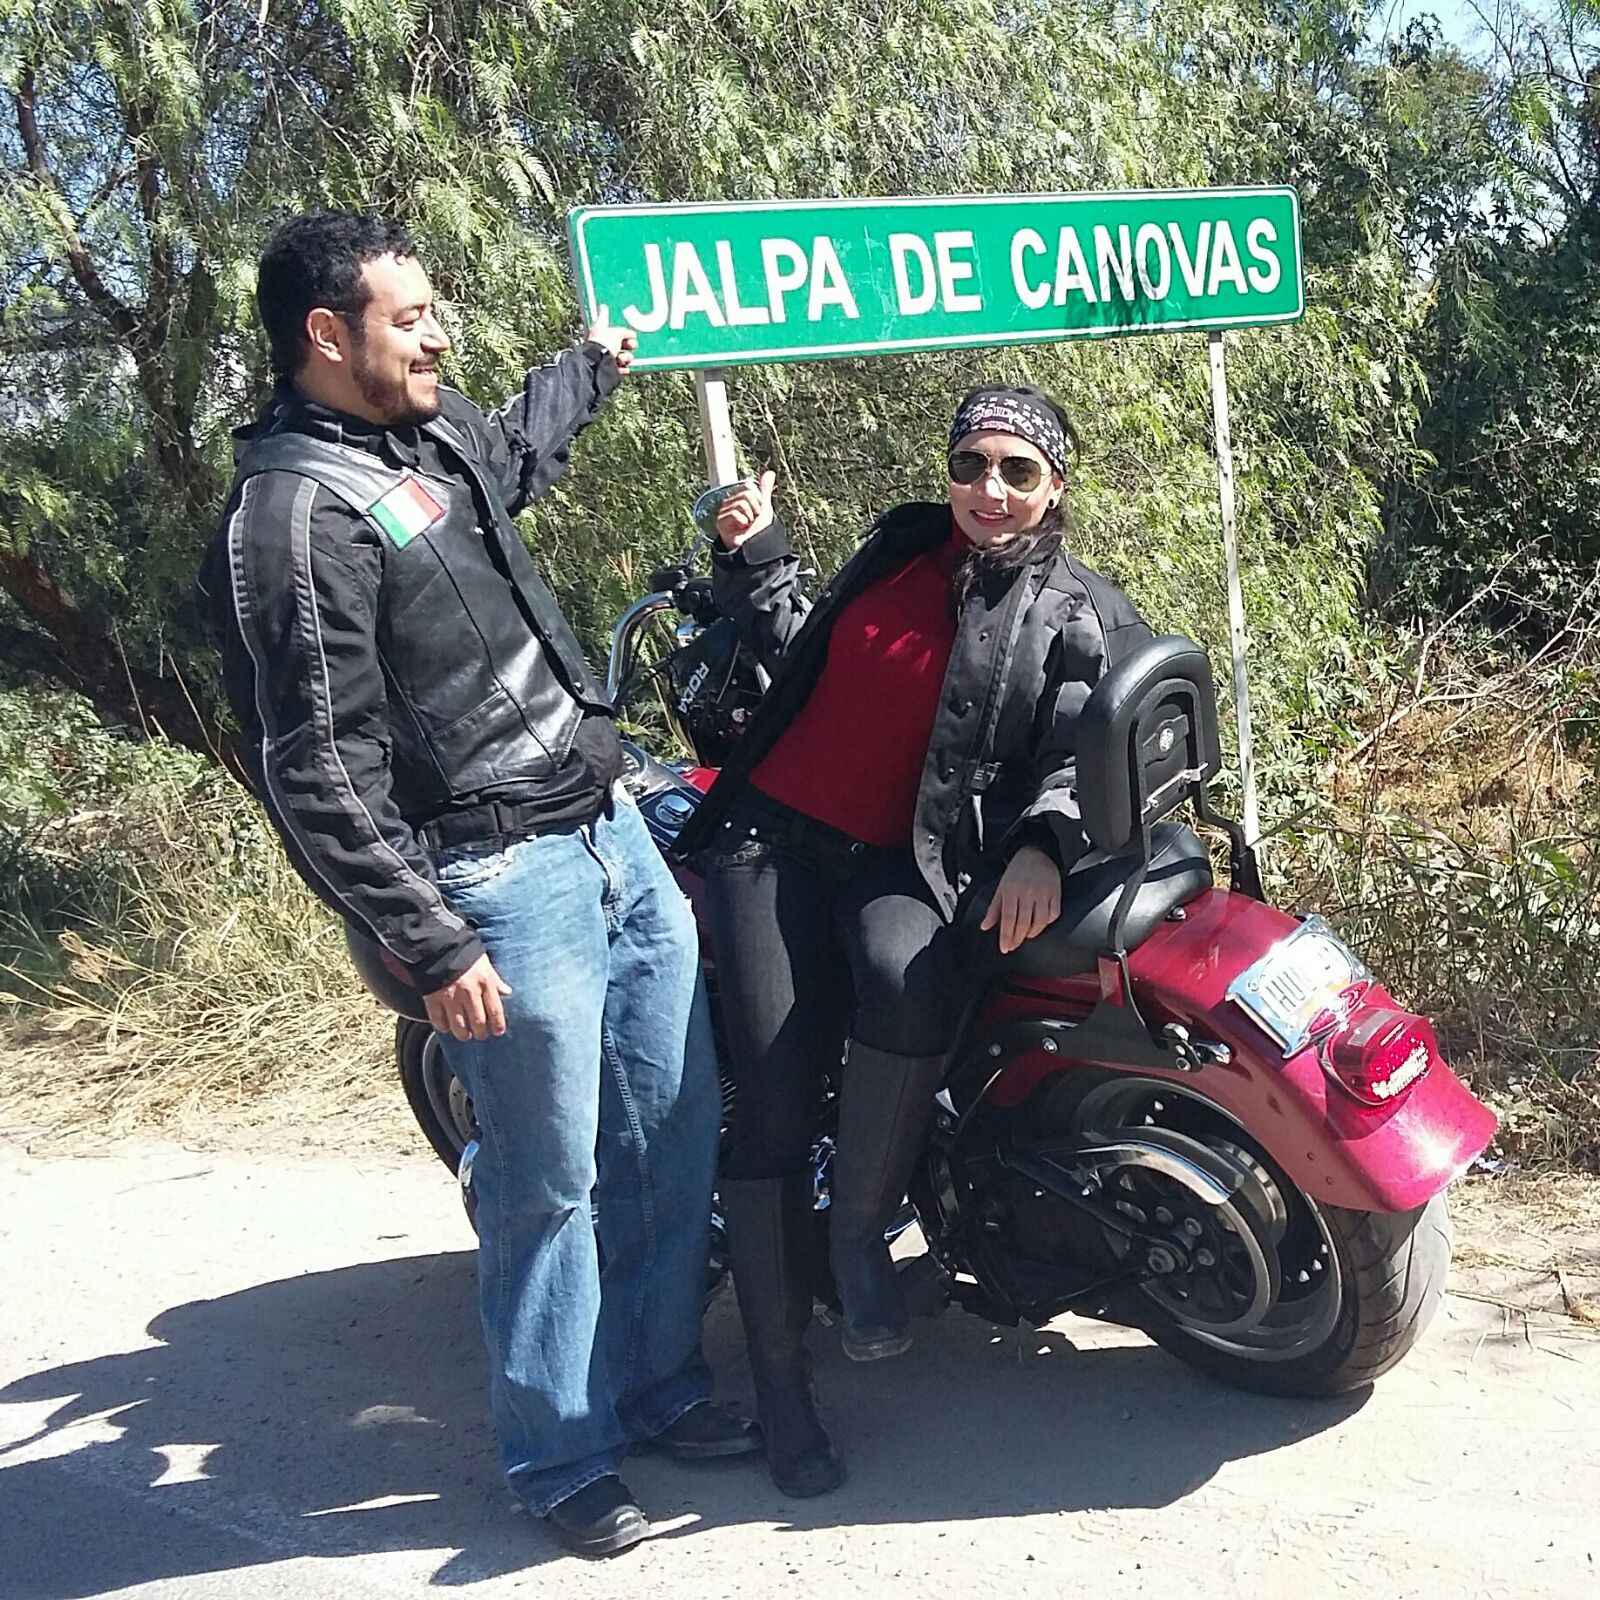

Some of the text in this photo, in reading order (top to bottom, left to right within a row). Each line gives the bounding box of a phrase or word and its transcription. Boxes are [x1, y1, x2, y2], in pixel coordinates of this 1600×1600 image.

[622, 218, 1281, 333] JALPA DE CANOVAS
